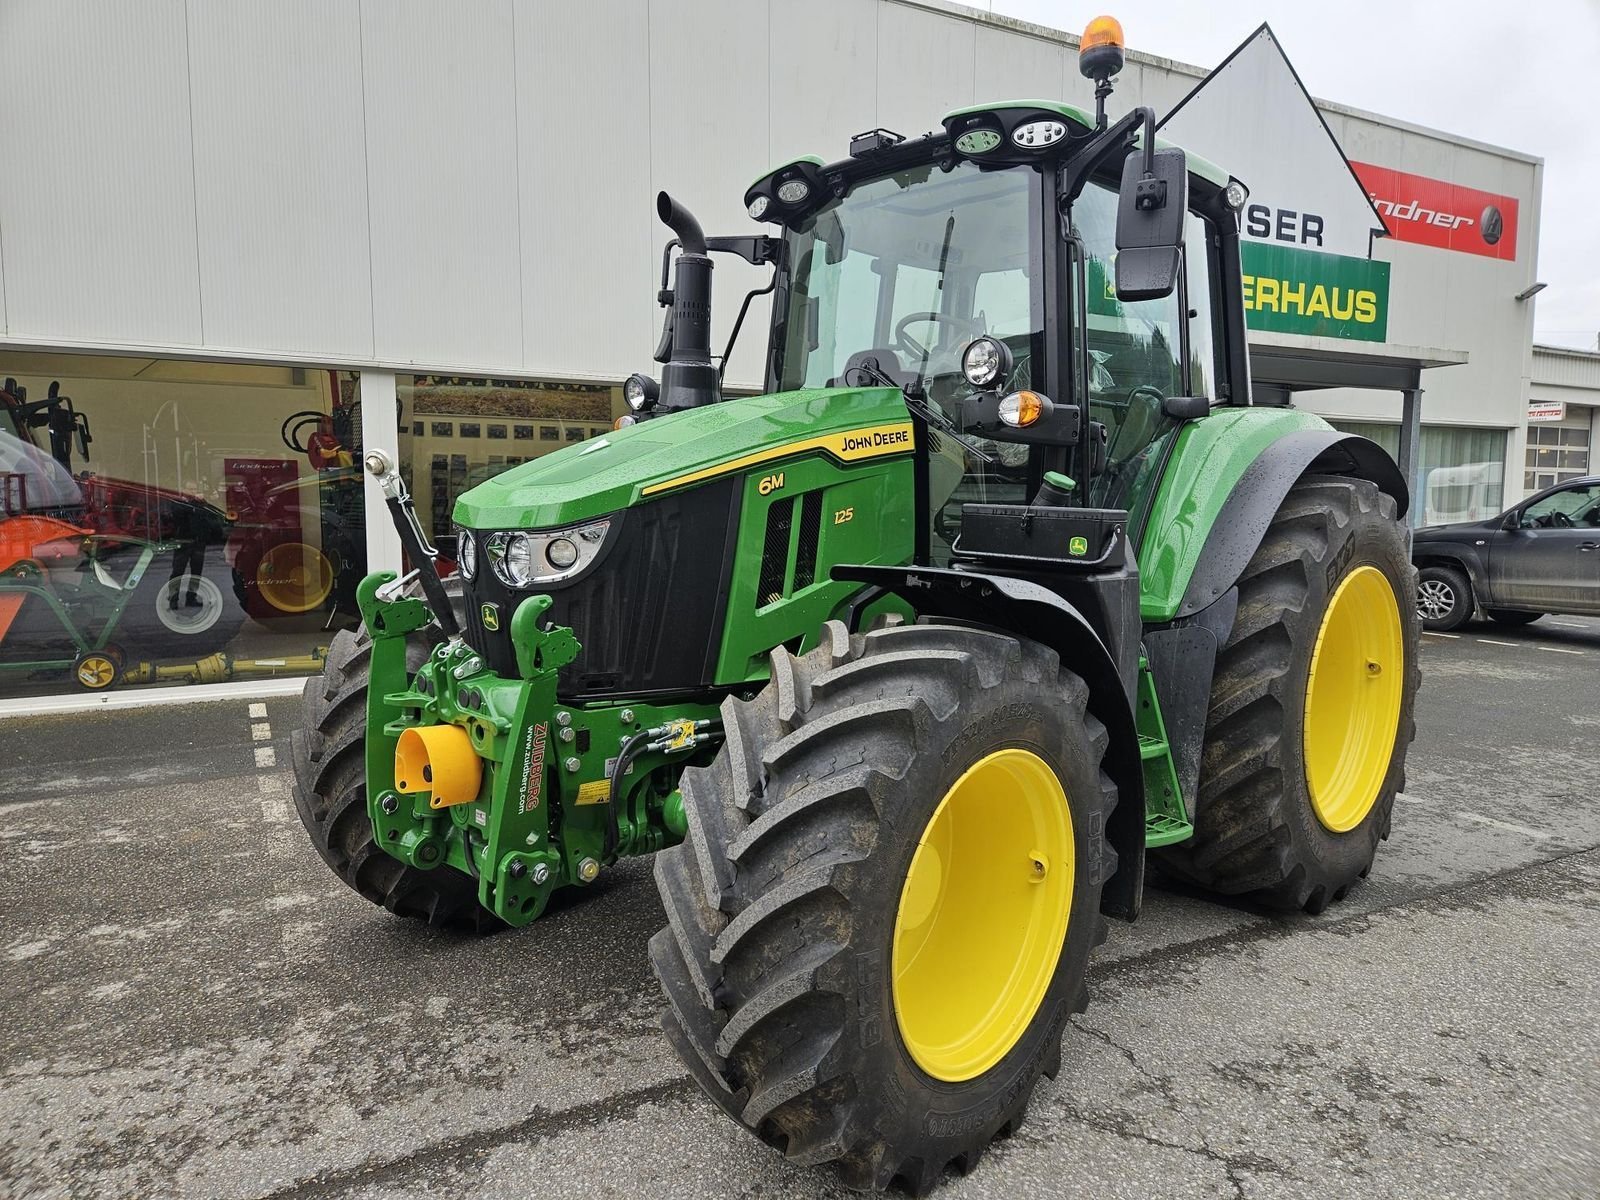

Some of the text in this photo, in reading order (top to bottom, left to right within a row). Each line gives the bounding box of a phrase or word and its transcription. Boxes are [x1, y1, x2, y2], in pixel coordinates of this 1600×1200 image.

[1246, 203, 1324, 247] SER
[841, 430, 909, 452] JOHN DEERE
[758, 472, 785, 496] 6M
[834, 507, 855, 526] 125
[518, 724, 534, 815] www.zuidberg.com
[525, 721, 548, 811] ZUIDBERG
